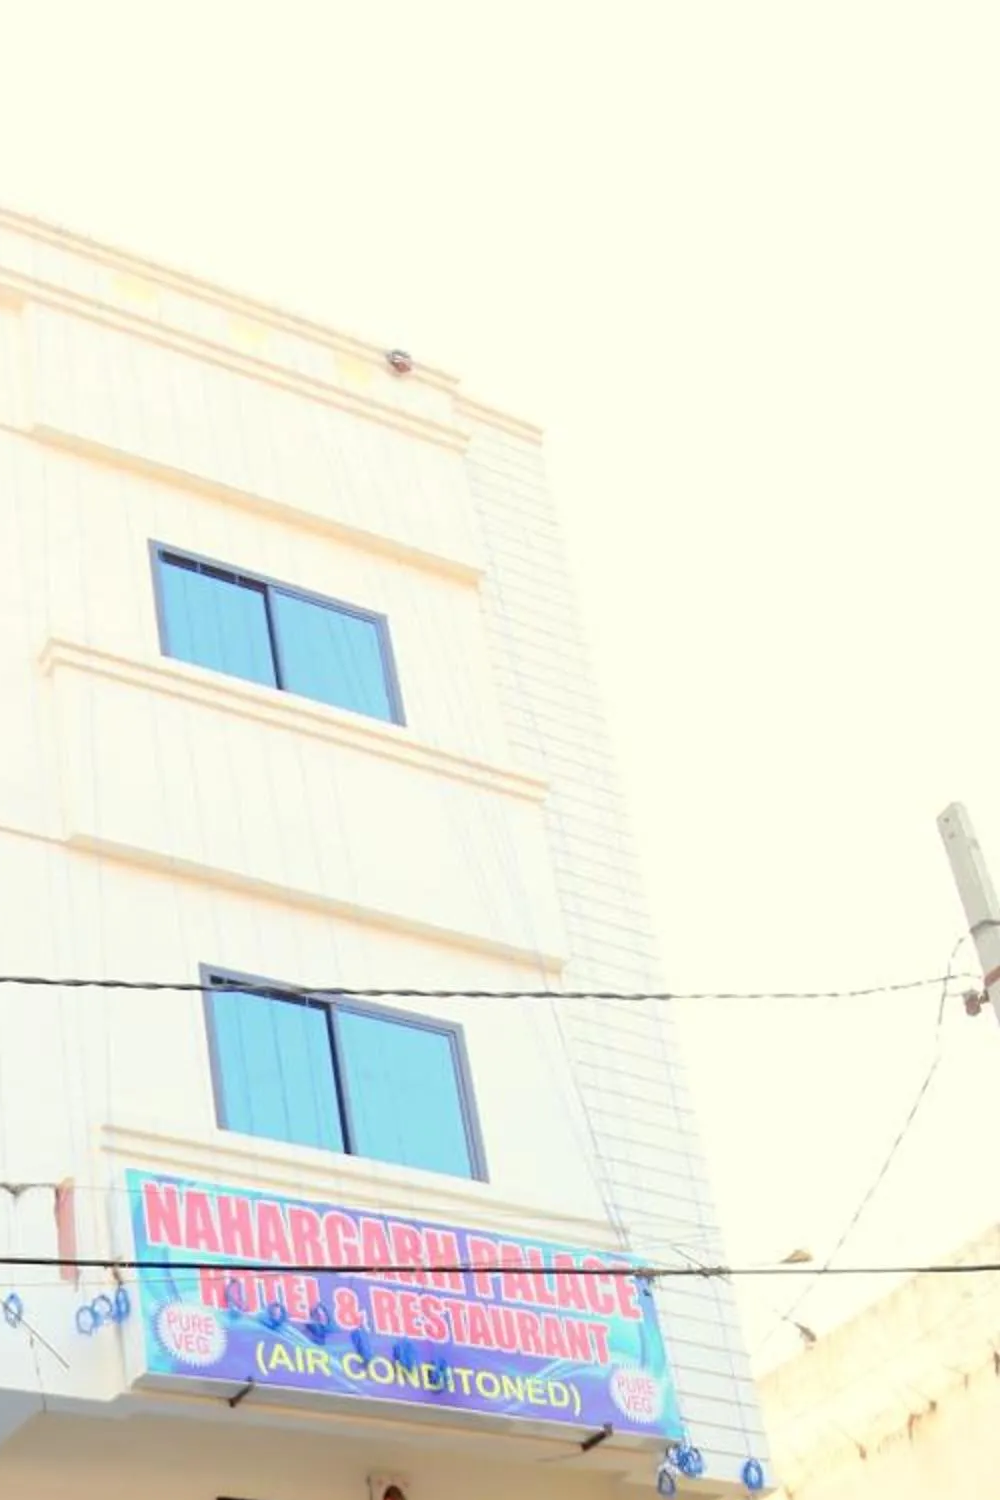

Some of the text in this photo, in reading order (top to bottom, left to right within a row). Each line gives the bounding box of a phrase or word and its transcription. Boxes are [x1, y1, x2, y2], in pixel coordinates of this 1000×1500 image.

[143, 1182, 641, 1321] NAHARGARH PALACE
[166, 1311, 216, 1336] PURE
[199, 1264, 611, 1367] HOTEL & RESTAURANT
[172, 1332, 211, 1356] VEG
[256, 1342, 582, 1417] (AIR CONDITONED)
[617, 1374, 657, 1397] PURE
[622, 1394, 655, 1415] VEG
